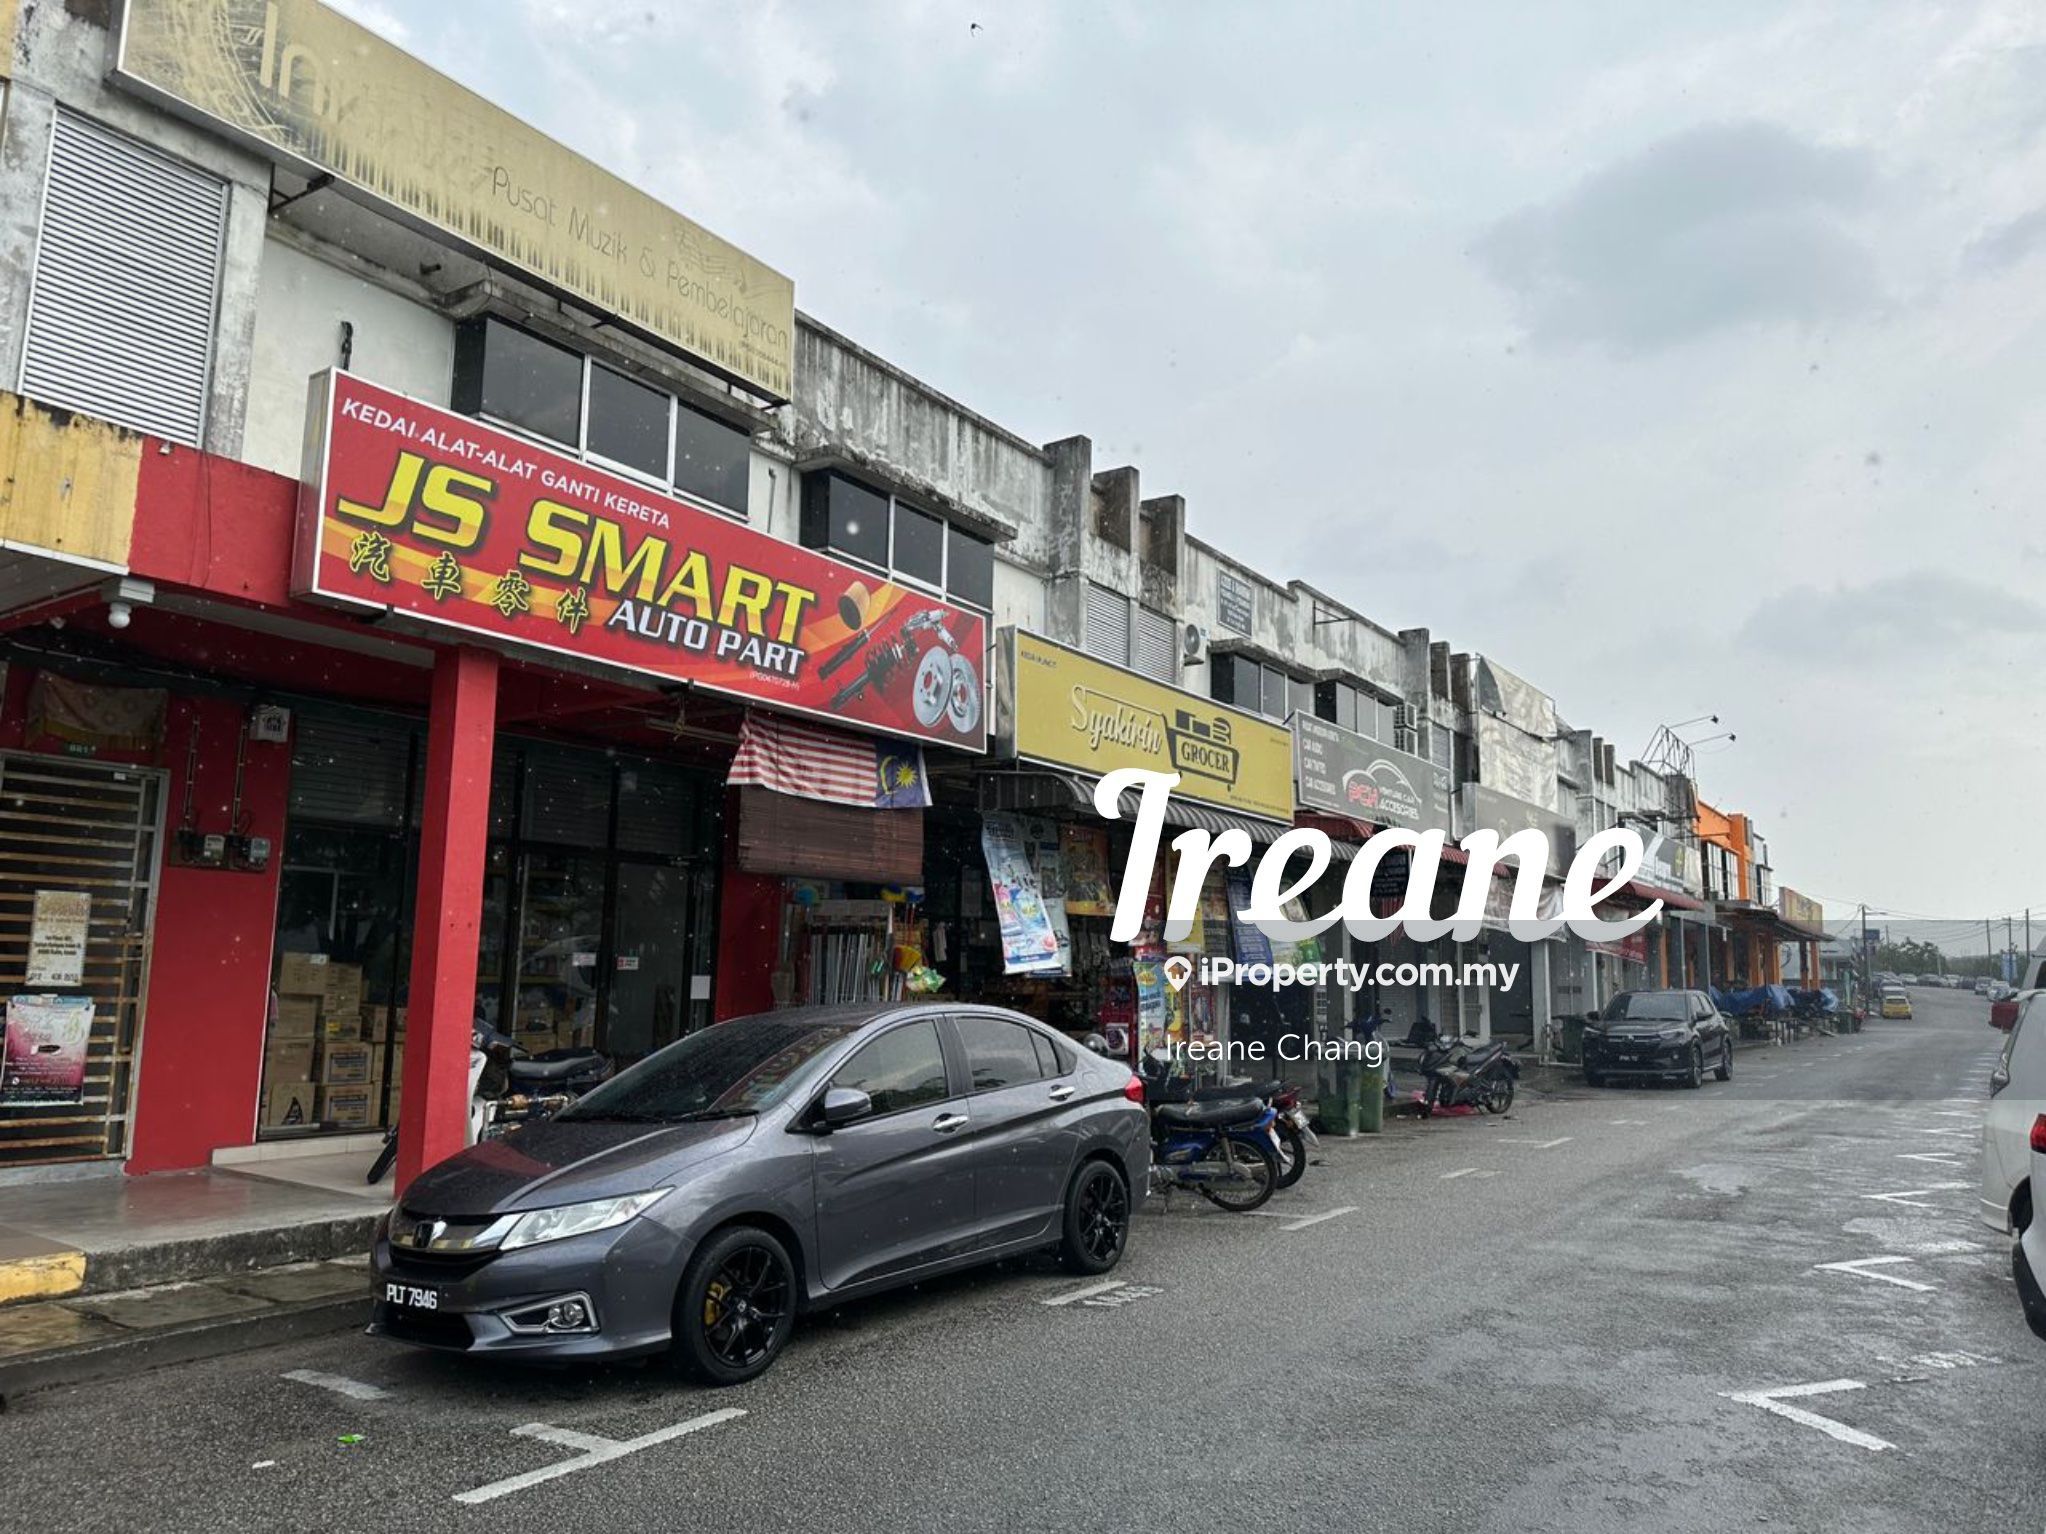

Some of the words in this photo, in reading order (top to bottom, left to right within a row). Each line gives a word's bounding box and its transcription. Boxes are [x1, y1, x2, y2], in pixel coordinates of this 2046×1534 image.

[492, 166, 557, 227] Pusat
[568, 207, 628, 264] Muzik
[667, 260, 788, 350] Pembelajaran
[341, 398, 417, 438] KEDAI
[420, 428, 538, 479] ALAT-ALAT
[541, 470, 600, 503] GANTI
[604, 492, 670, 530] KERETA
[337, 451, 493, 548] JS
[518, 499, 816, 645] SMART
[608, 600, 709, 650] AUTO
[716, 628, 805, 676] PART
[1071, 684, 1163, 755] Syakirin
[1181, 741, 1230, 774] GROCER
[386, 1283, 407, 1305] PLT
[408, 1287, 438, 1310] 7946
